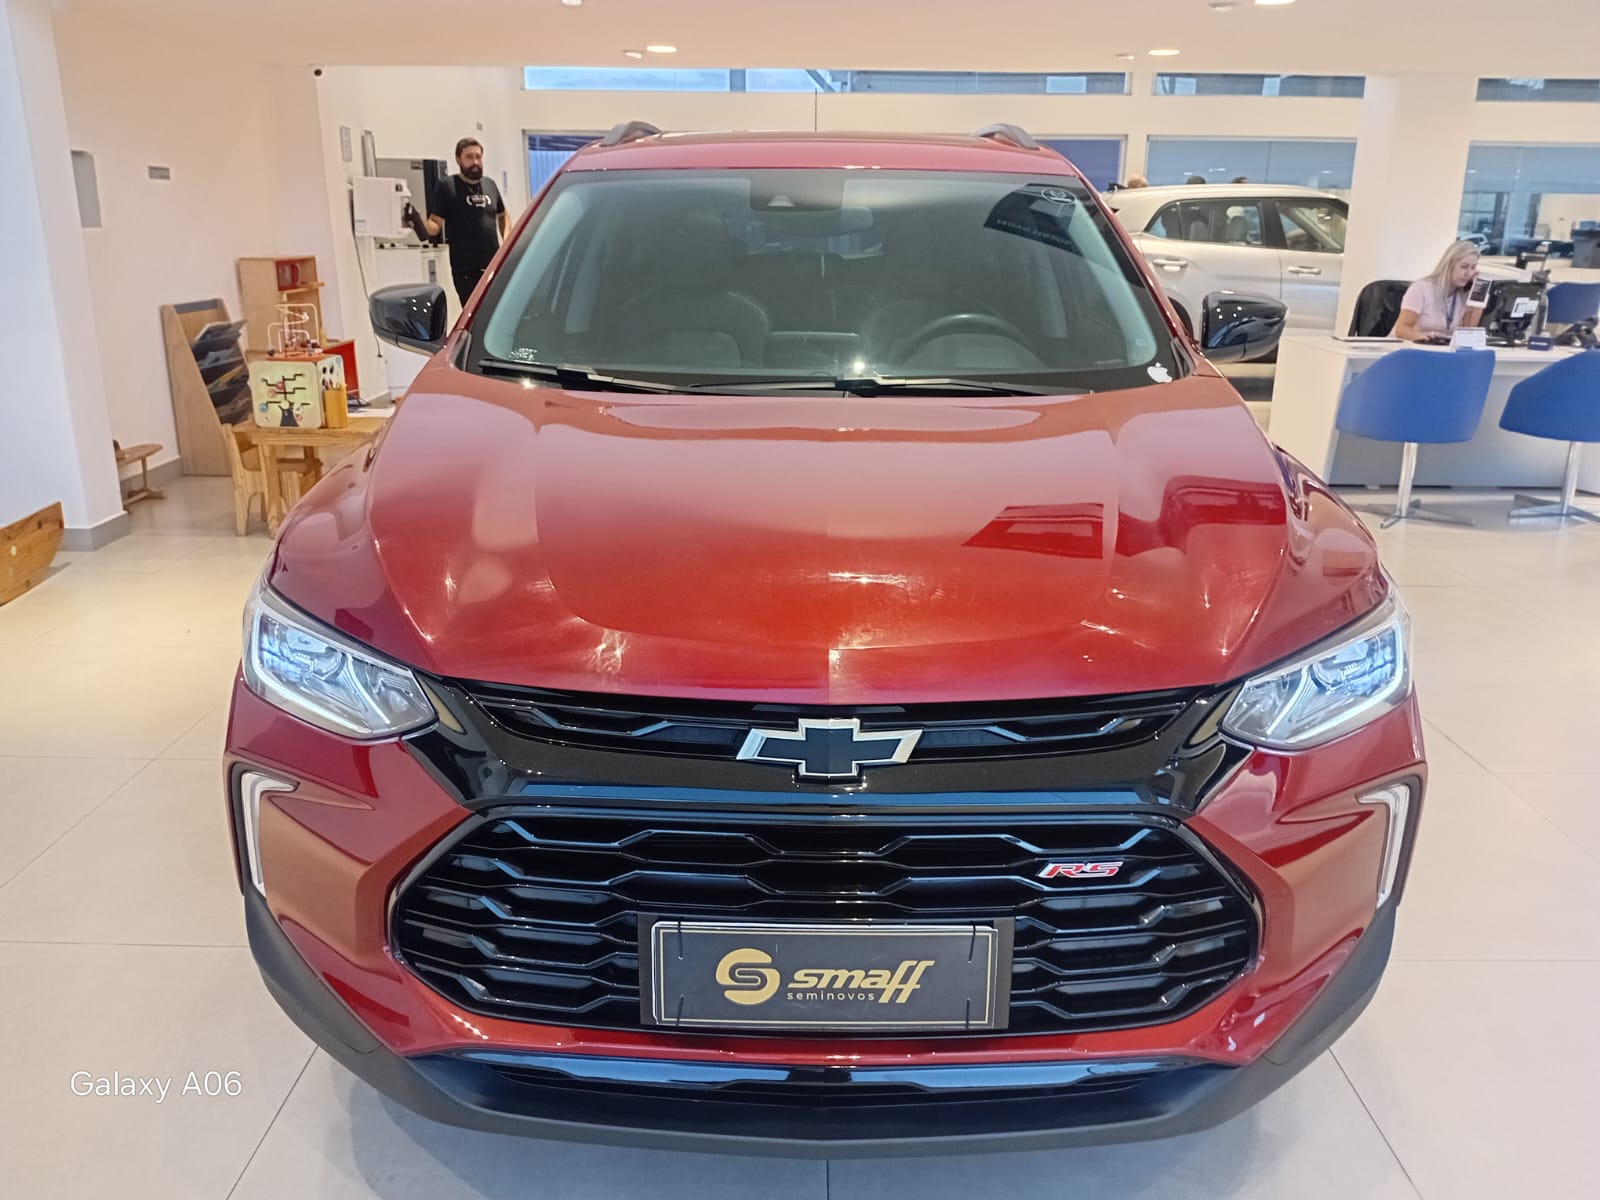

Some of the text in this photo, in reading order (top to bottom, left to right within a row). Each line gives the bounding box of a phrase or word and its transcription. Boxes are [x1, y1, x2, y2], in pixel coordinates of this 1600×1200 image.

[1038, 861, 1123, 878] RS
[787, 960, 936, 1004] smaff
[787, 991, 875, 1001] seminovos
